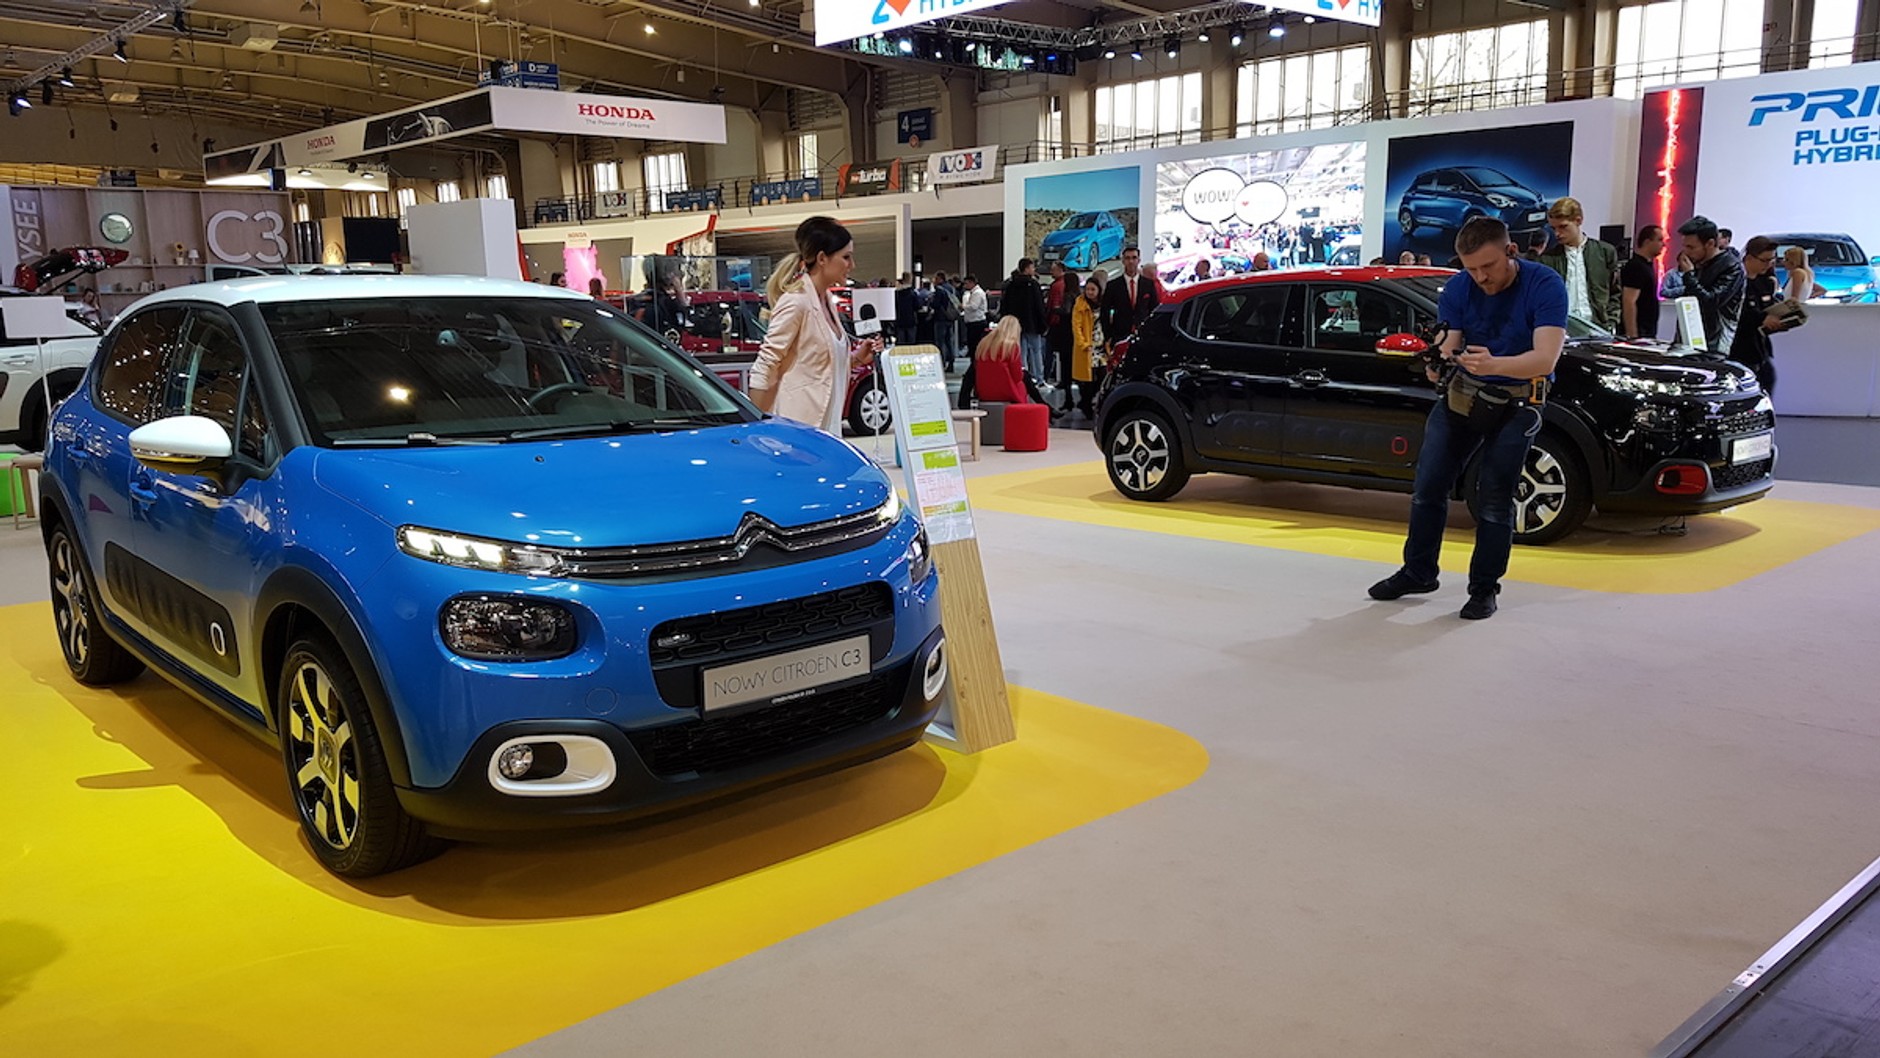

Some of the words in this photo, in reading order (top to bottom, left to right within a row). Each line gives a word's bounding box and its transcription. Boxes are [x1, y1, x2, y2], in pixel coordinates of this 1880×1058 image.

[577, 103, 656, 121] HONDA
[1748, 85, 1880, 126] PRI
[626, 121, 650, 129] Dreams
[901, 115, 910, 132] 4
[1795, 126, 1880, 147] PLUG-
[207, 210, 289, 263] C3
[713, 671, 767, 698] NOWY
[772, 653, 837, 684] CITROËN
[841, 648, 862, 668] C3
